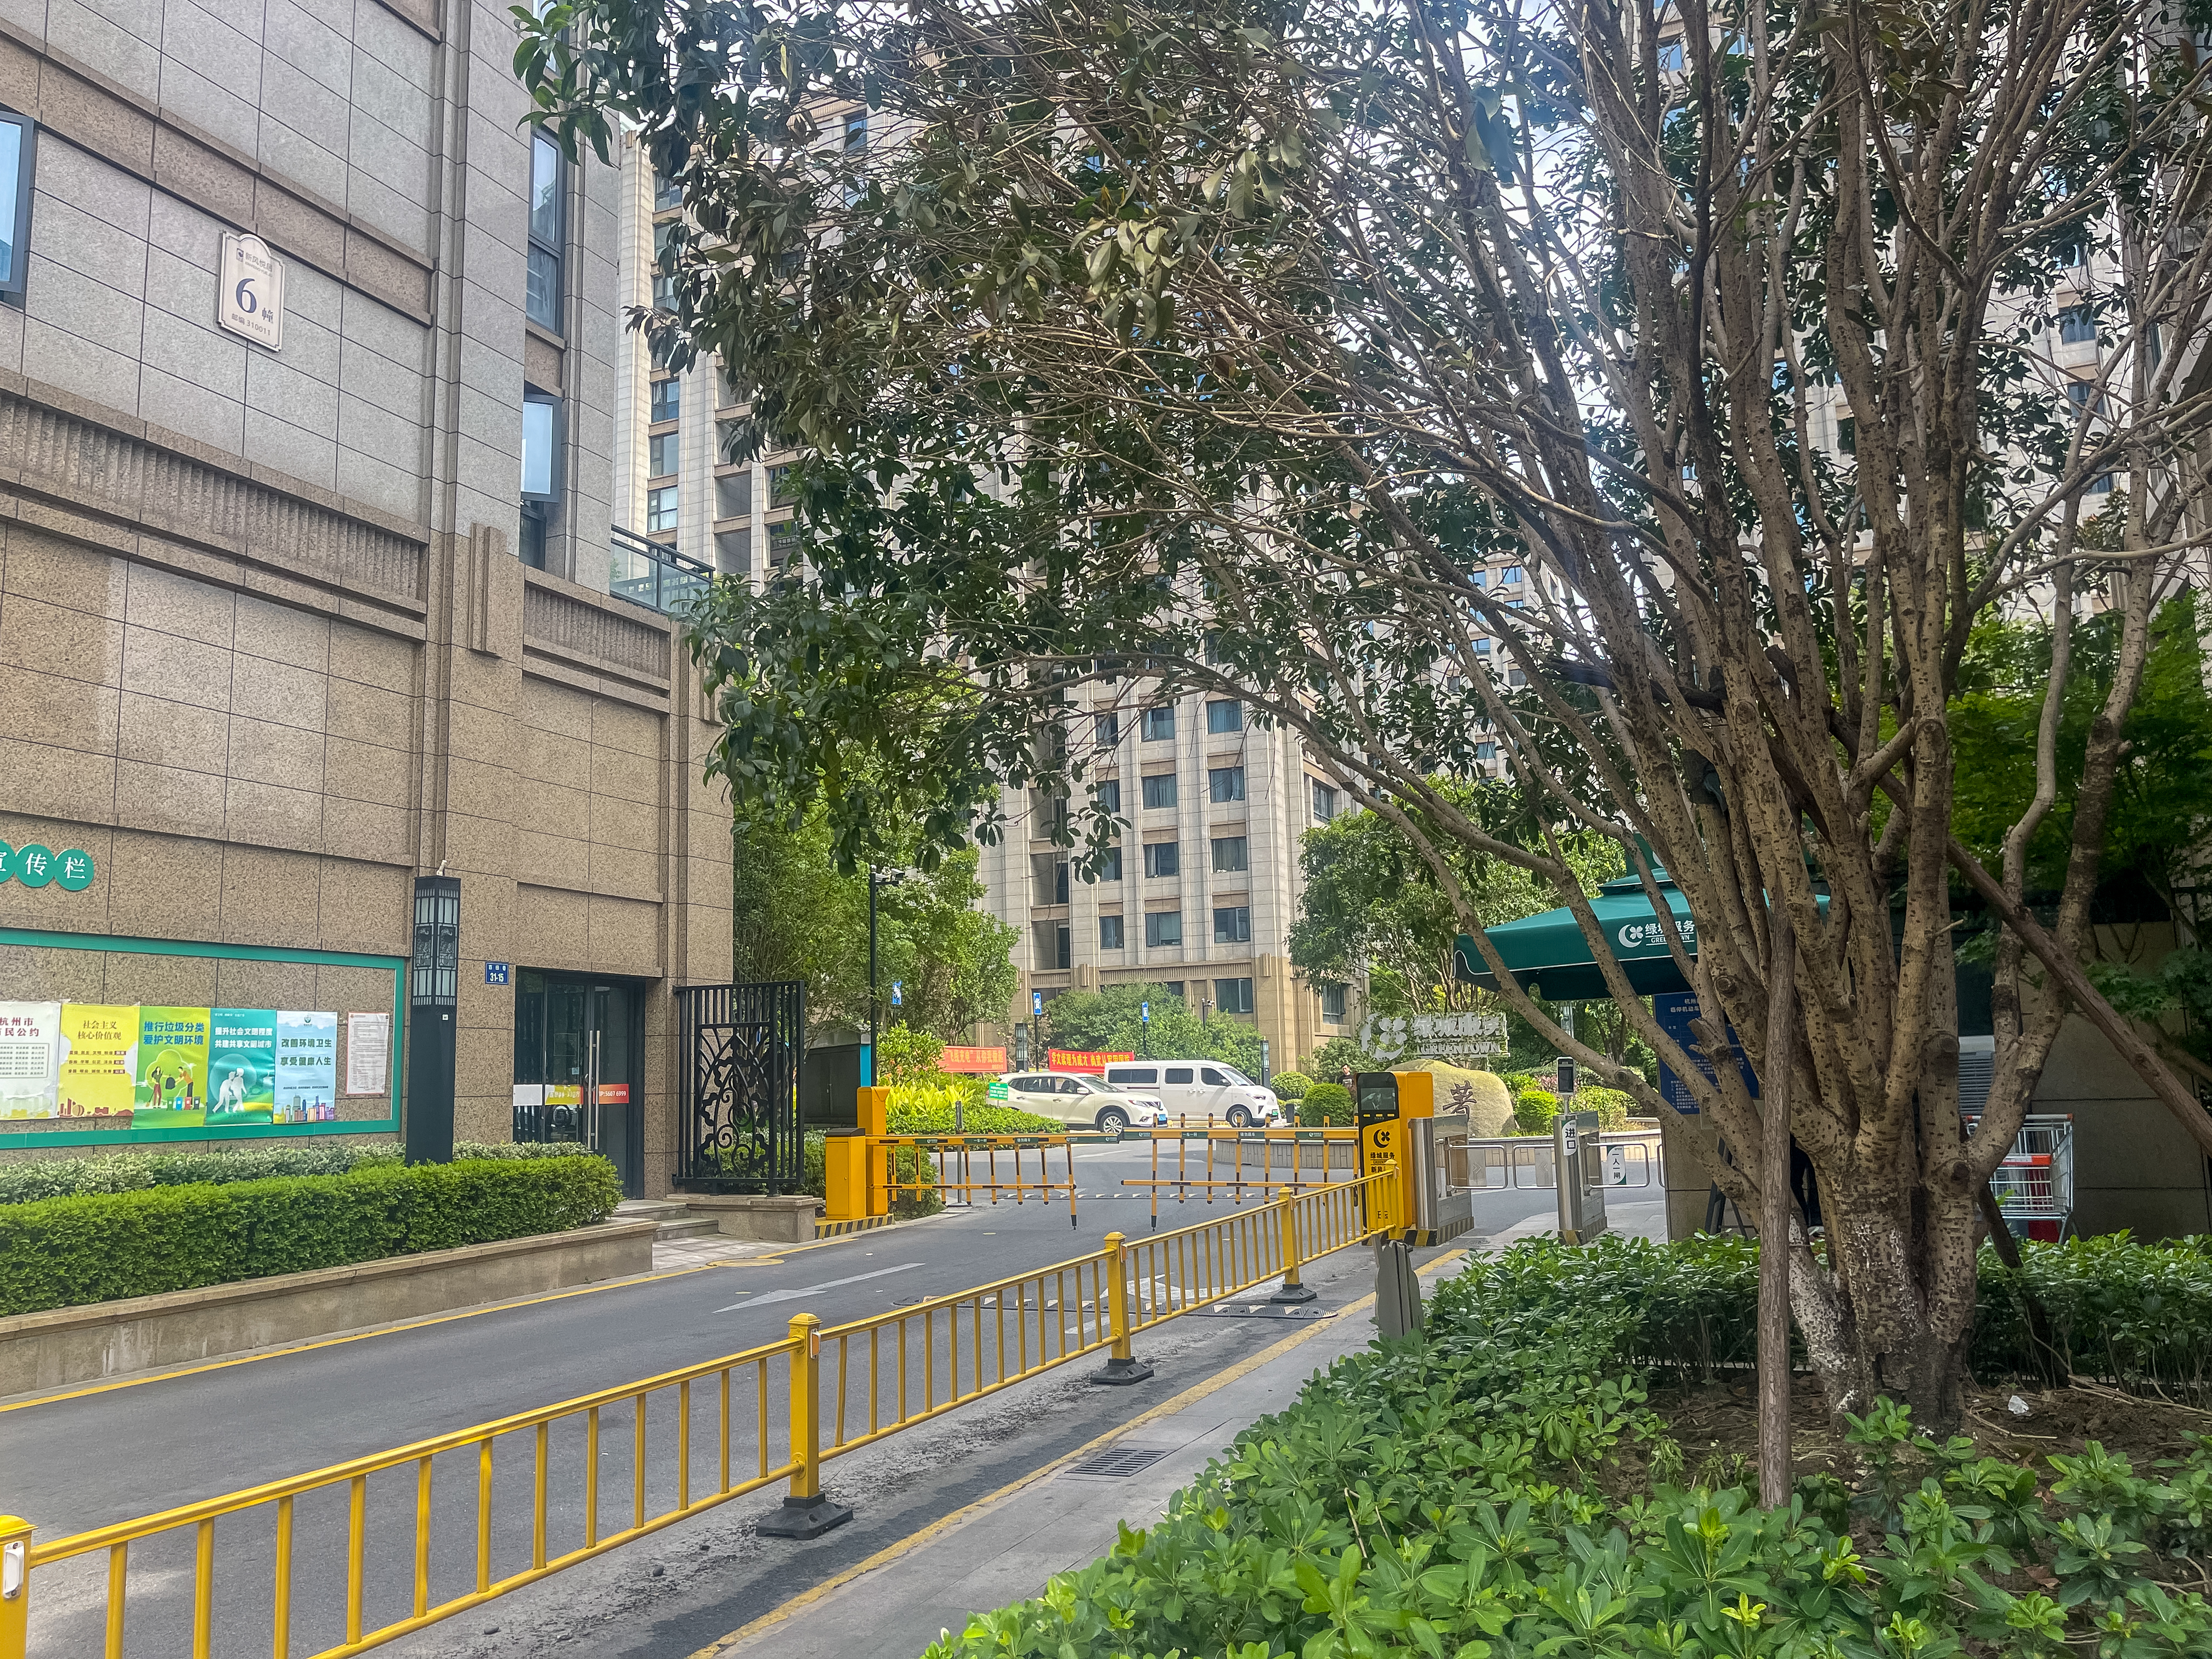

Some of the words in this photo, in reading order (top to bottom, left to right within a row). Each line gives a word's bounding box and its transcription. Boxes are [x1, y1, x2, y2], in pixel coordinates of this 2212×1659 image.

[236, 278, 257, 313] 6
[247, 320, 270, 336] 310011
[490, 973, 504, 982] 31-15
[0, 1017, 33, 1026] 杭州市
[83, 1020, 117, 1029] 社会主义
[144, 1021, 205, 1032] 推行垃圾分类
[1412, 1012, 1500, 1037] 绿城服务
[78, 1031, 121, 1040] 核心价值观
[215, 1026, 273, 1036] 提升社会文明程度
[143, 1035, 204, 1045] 爱护文明环境
[215, 1040, 272, 1048] 共建共享文明城市
[281, 1038, 332, 1048] 改善环境卫生
[1421, 1043, 1500, 1054] GREENTOWN
[280, 1056, 331, 1066] 享受健康人生
[1565, 1128, 1576, 1149] 进口
[1612, 1153, 1621, 1179] 一人一闸
